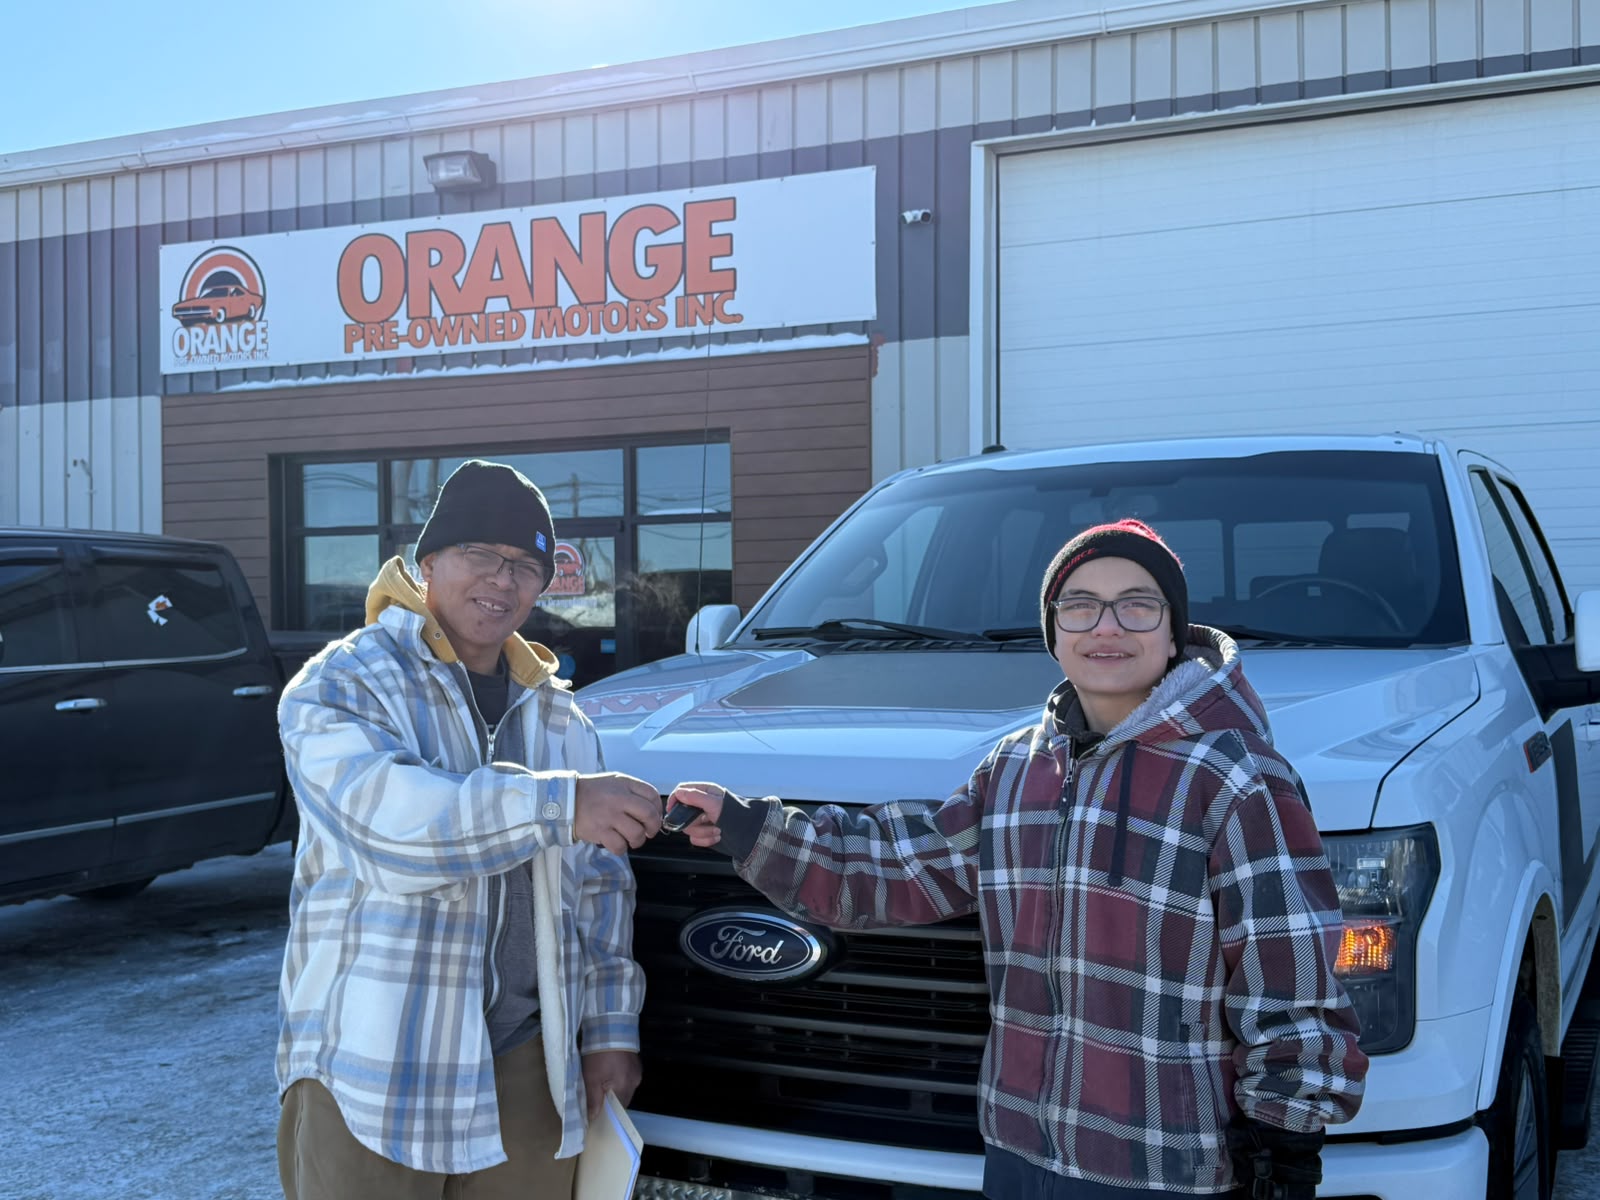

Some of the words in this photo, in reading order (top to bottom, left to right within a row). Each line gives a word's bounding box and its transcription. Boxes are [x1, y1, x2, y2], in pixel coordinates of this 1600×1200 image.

[336, 196, 737, 324] ORANGE
[172, 320, 269, 359] ORANGE
[343, 310, 527, 354] PRE-OWNED
[532, 298, 668, 340] MOTORS
[675, 291, 744, 329] INC.
[710, 925, 785, 965] Ford
